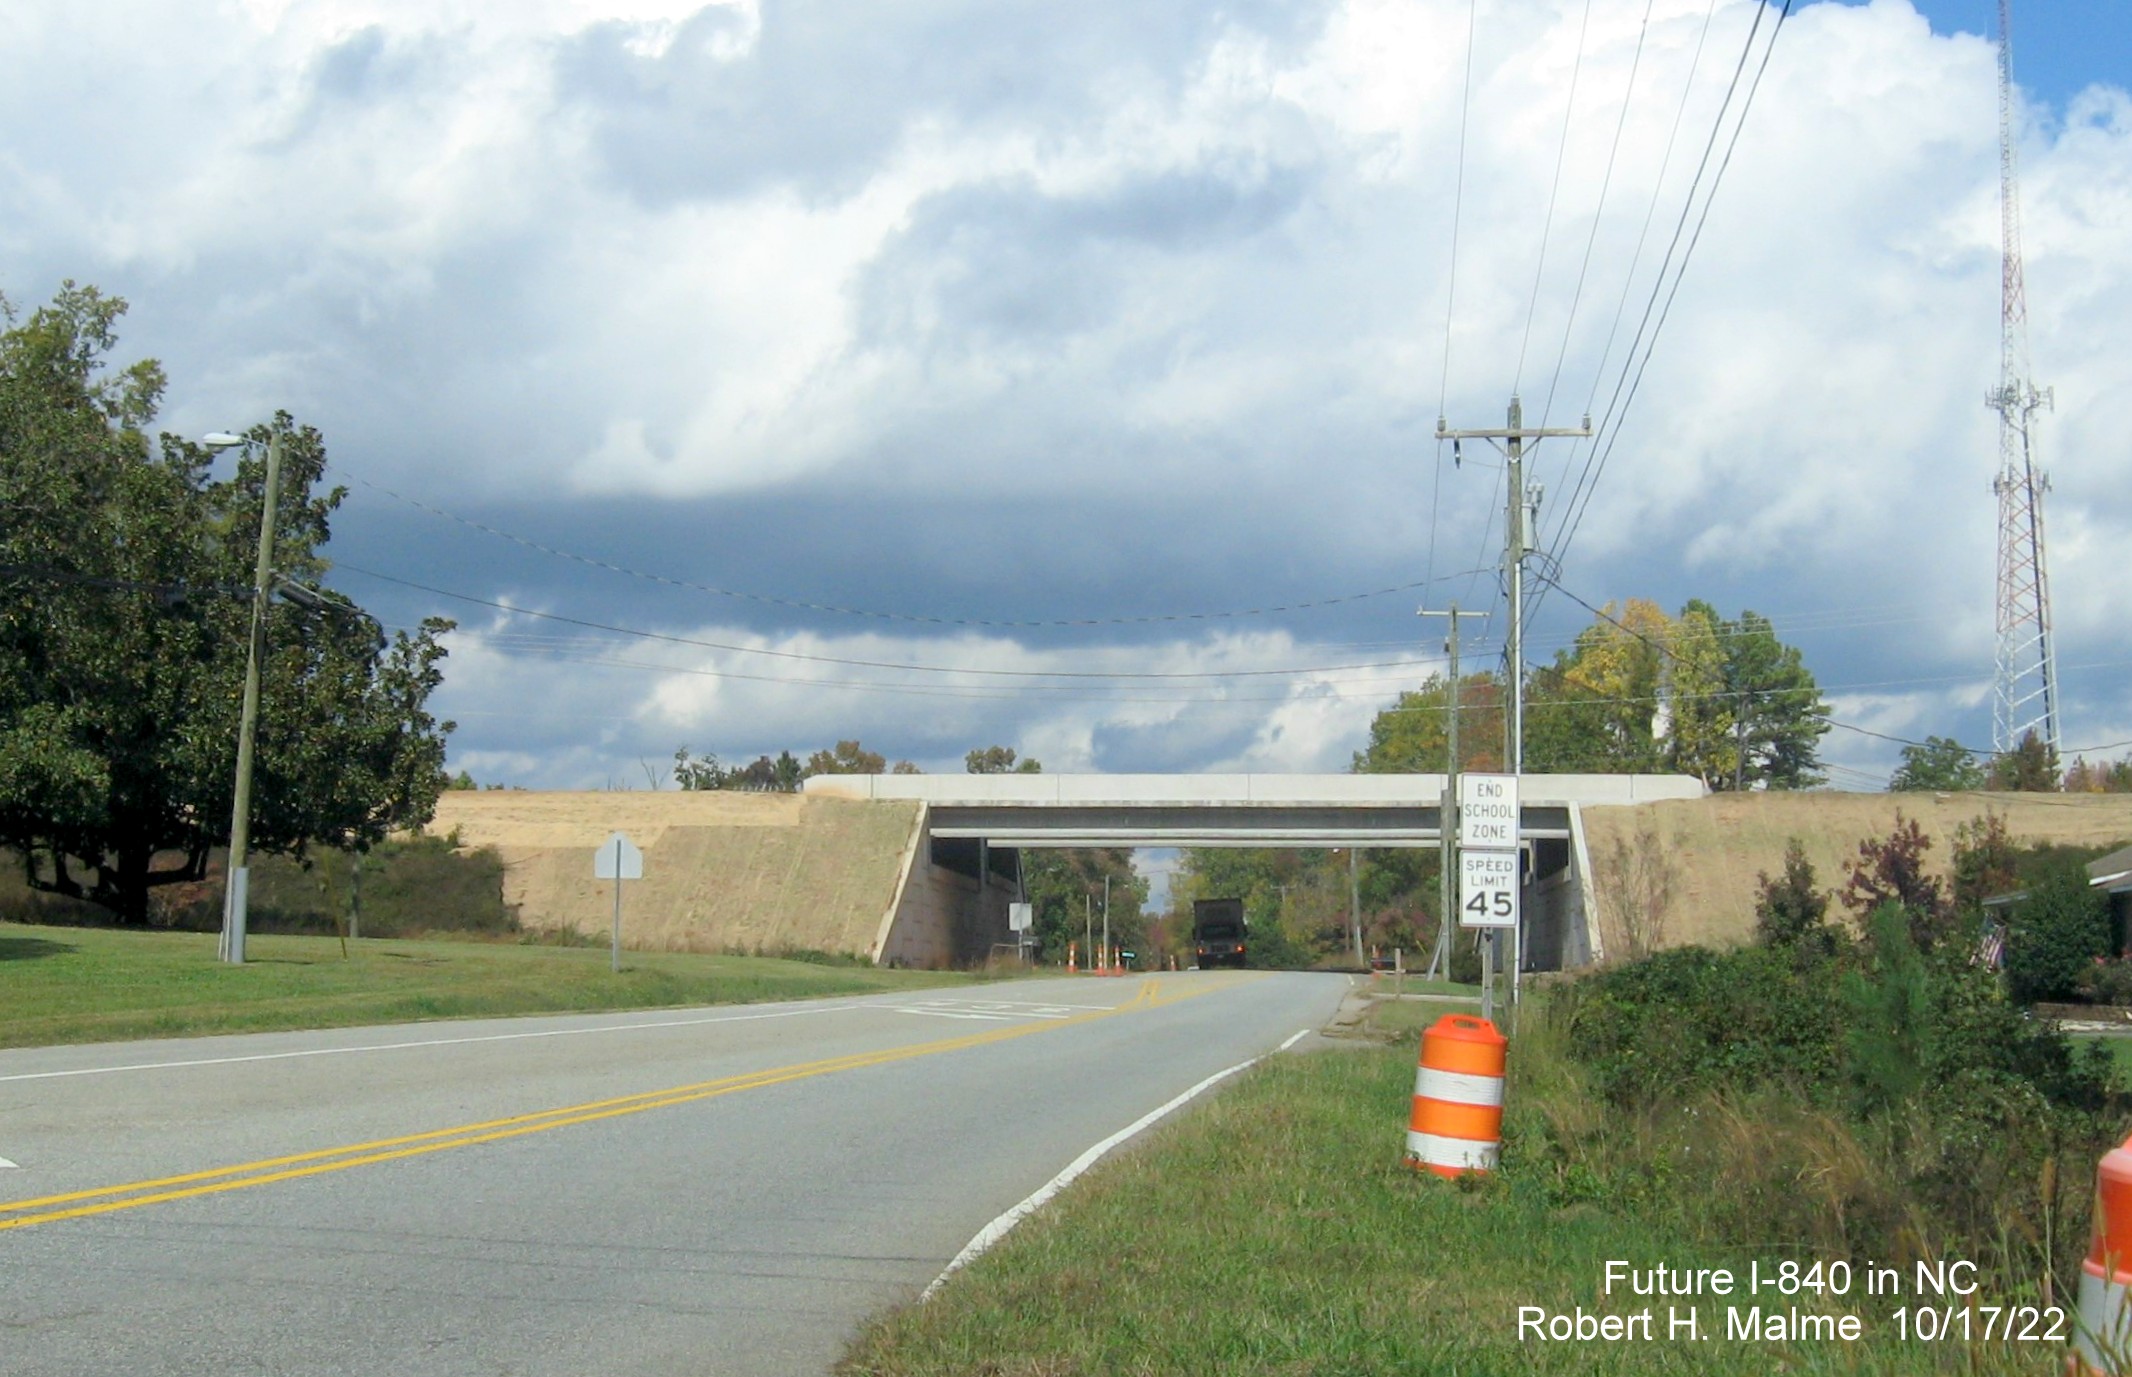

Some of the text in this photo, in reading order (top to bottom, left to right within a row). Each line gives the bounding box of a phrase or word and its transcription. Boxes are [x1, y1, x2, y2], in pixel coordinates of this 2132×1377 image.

[1477, 783, 1503, 798] END
[1464, 804, 1516, 819] SCHOOL
[1472, 824, 1507, 839] ZONE
[1466, 860, 1514, 873] SPEED
[1471, 876, 1508, 887] LIMIT
[1466, 891, 1513, 917] 45
